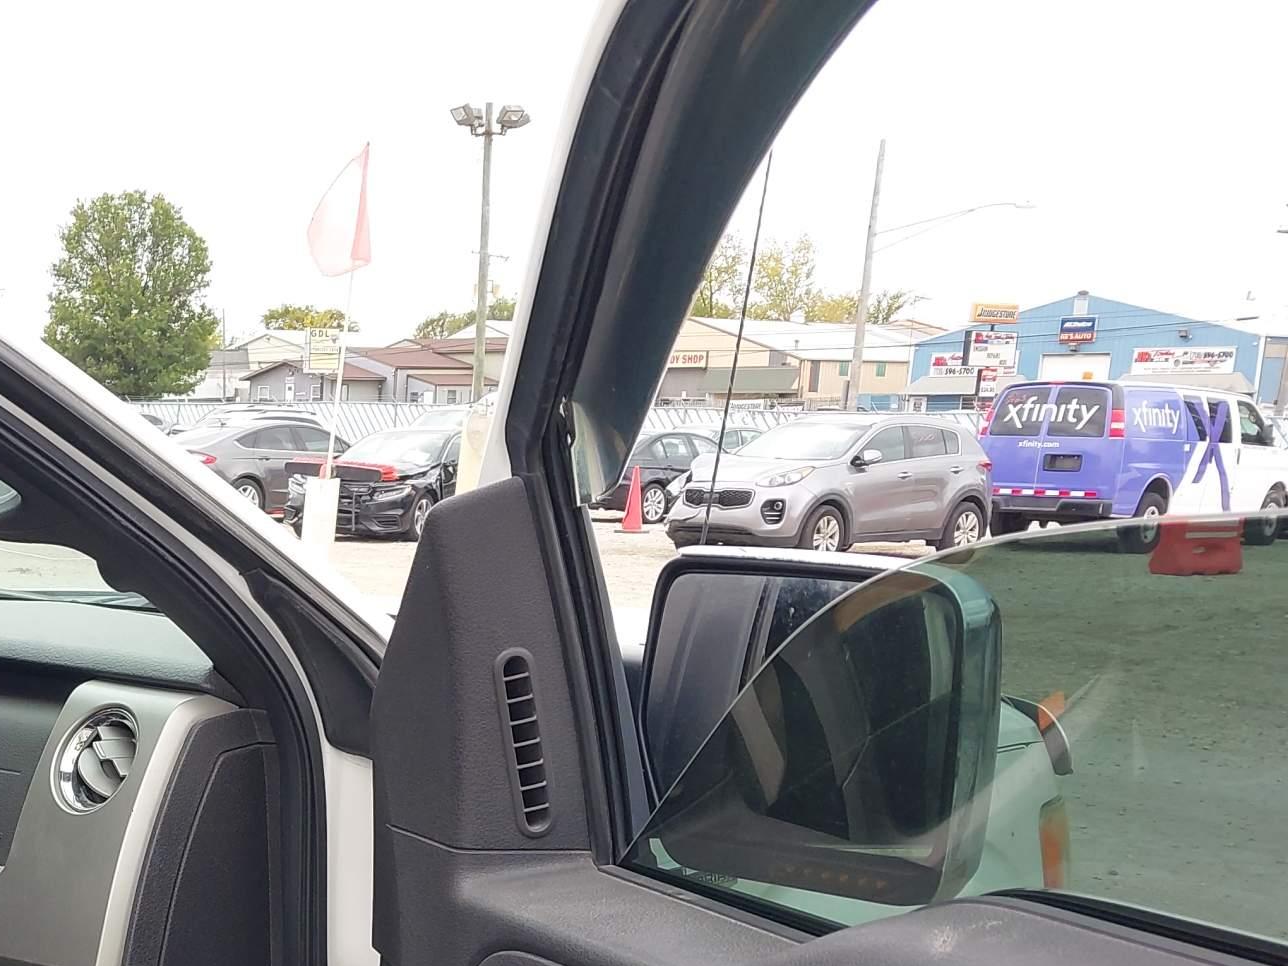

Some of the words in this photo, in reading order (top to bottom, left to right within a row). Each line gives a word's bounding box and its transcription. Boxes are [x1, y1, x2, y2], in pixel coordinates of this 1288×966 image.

[682, 353, 705, 364] SHOP
[1003, 395, 1100, 430] xfinity
[1131, 400, 1181, 434] xfinity
[1018, 439, 1060, 449] xfinity.com
